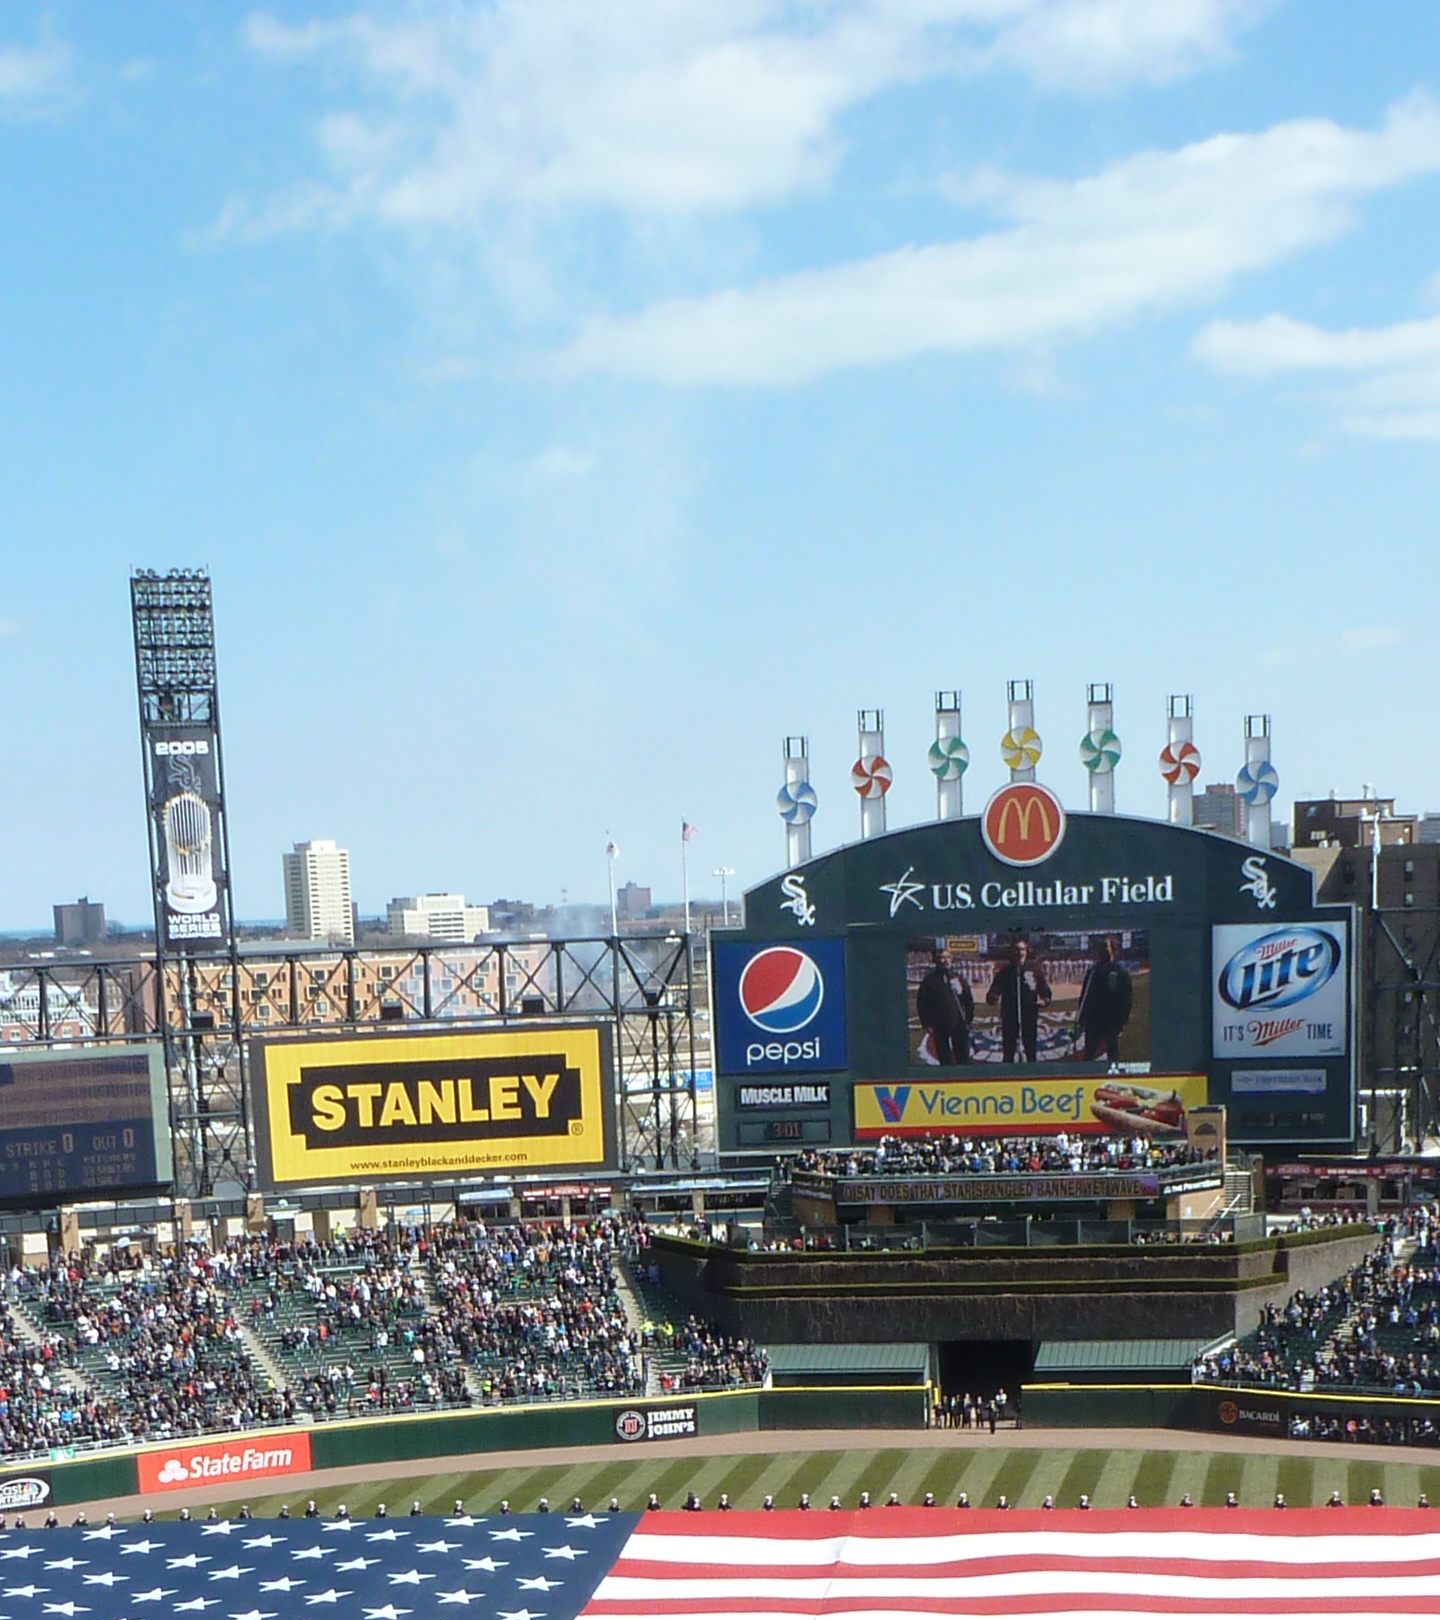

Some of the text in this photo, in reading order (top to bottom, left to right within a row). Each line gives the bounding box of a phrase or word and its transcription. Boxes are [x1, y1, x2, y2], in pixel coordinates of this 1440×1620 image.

[155, 741, 209, 756] 2005
[931, 876, 1174, 909] U.S. Cellular Field
[168, 914, 221, 924] WORLD
[169, 923, 221, 933] SERIES
[1254, 938, 1299, 960] Miller
[1236, 943, 1324, 1012] Lite
[1223, 1017, 1333, 1047] IT'S Miller TIME
[746, 1036, 821, 1066] pepsi
[311, 1074, 560, 1132] STANLEY
[741, 1086, 828, 1105] MUSCLE MILK
[918, 1089, 1015, 1116] Vienna
[1021, 1087, 1084, 1120] Beef
[5, 1139, 57, 1158] STRIKE
[92, 1135, 118, 1151] OUT
[350, 1152, 528, 1171] www.stanleyblackanddecker.com
[880, 1183, 910, 1200] DOES
[914, 1182, 940, 1200] THAT
[1036, 1179, 1083, 1197] BANNER
[1109, 1178, 1141, 1195] WAVE
[647, 1408, 694, 1425] JIMMY
[648, 1421, 695, 1438] JOHN'S
